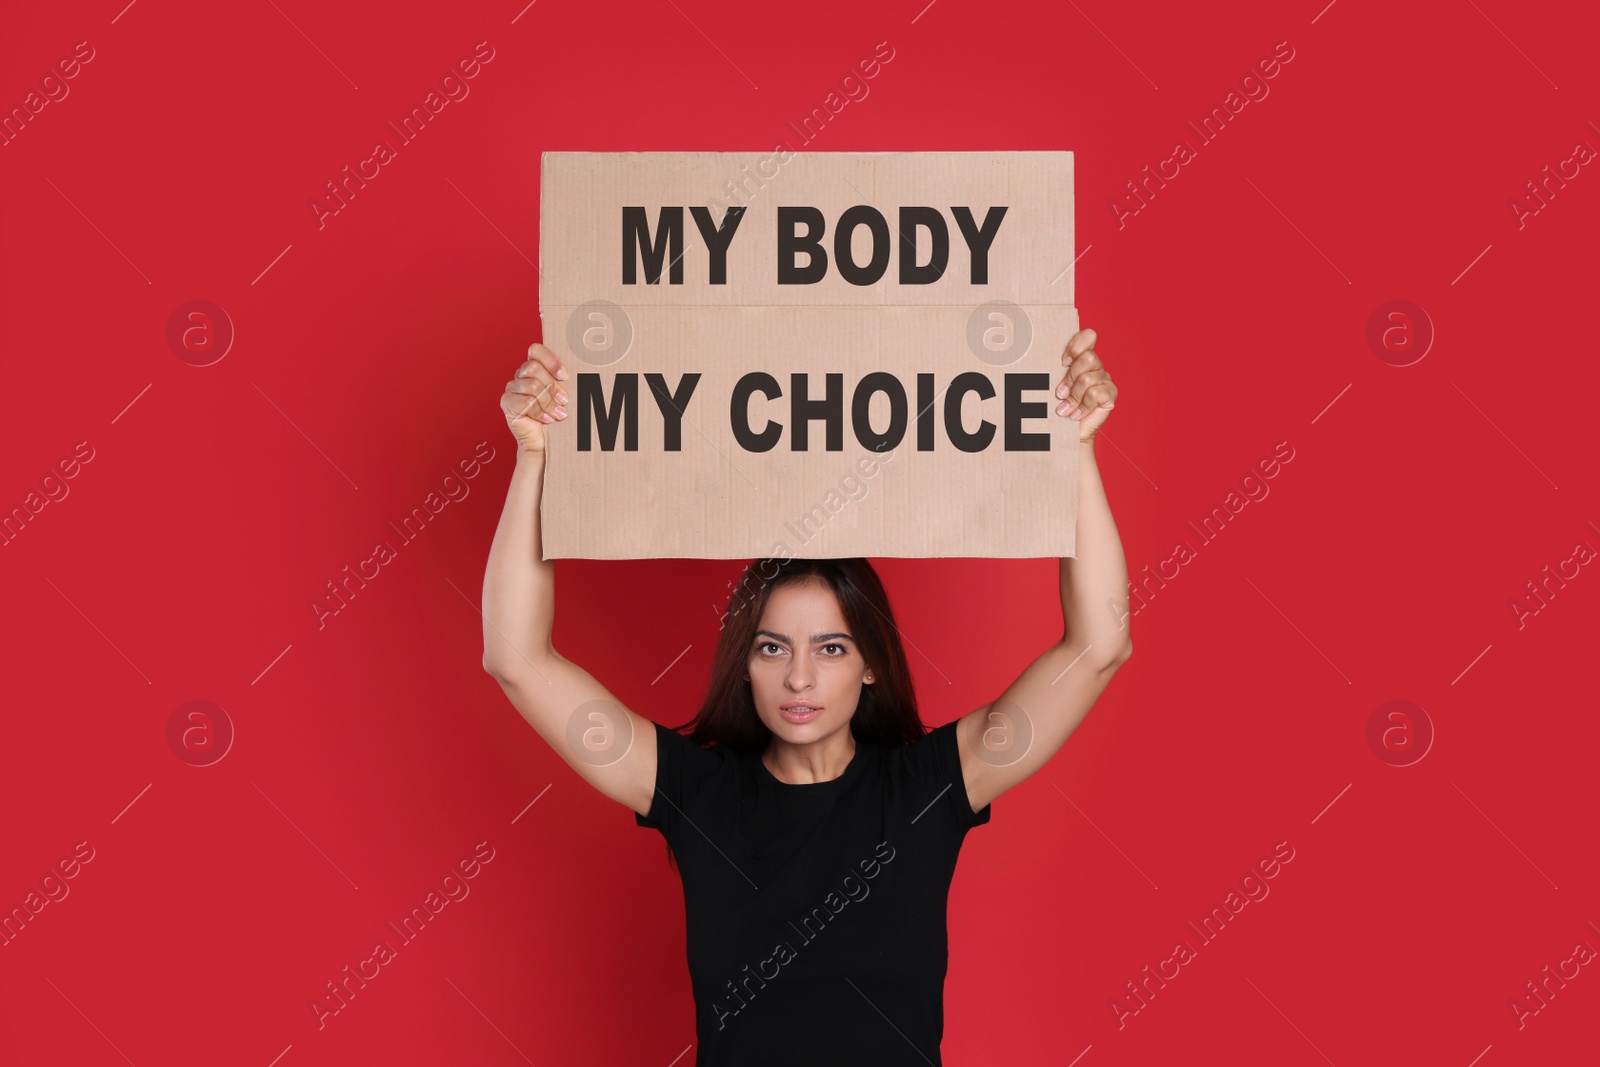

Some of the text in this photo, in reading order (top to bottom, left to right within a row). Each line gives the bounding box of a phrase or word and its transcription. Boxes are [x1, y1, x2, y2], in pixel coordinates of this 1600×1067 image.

[623, 205, 1008, 286] MY BODY
[577, 372, 1050, 452] MY CHOICE
